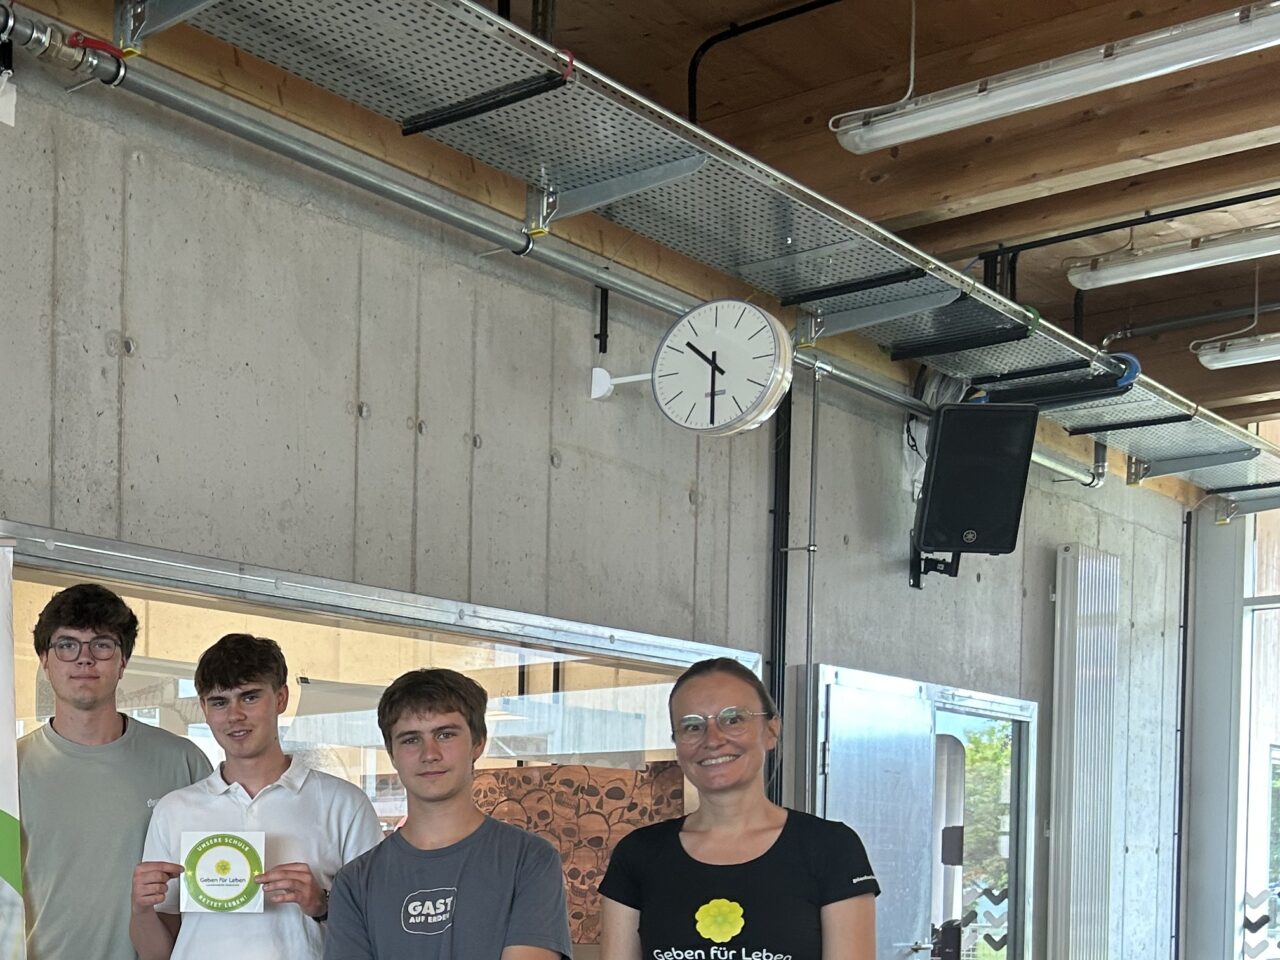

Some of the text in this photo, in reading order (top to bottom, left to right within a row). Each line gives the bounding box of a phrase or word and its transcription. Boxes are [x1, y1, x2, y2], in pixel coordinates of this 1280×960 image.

[196, 837, 250, 852] UNSERE SCHULE
[408, 896, 454, 915] GAST
[409, 915, 425, 923] AUF
[653, 947, 705, 960] Geben
[710, 946, 736, 960] für
